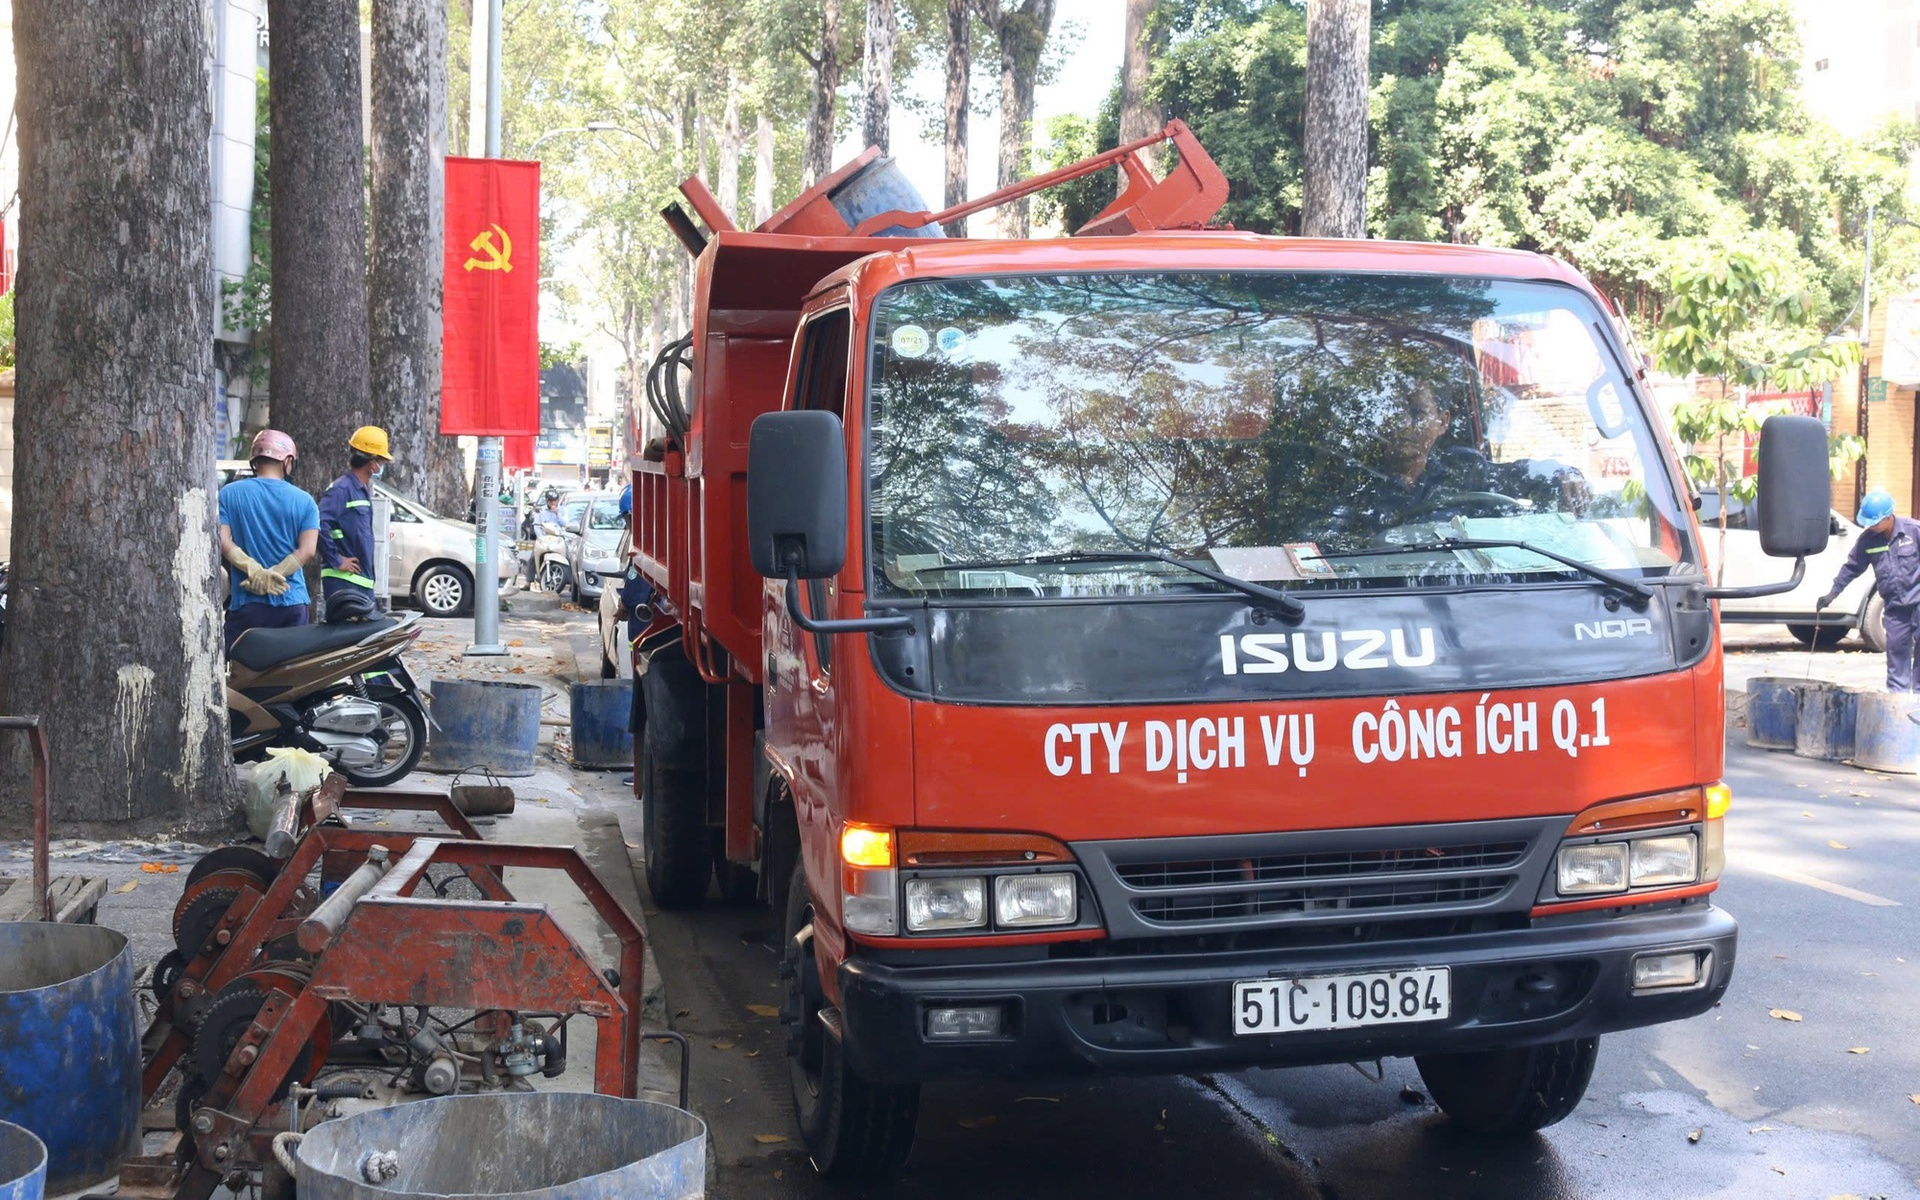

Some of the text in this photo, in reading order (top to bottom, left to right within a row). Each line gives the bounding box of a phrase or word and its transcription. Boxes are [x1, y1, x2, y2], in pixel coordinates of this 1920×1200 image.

[1219, 627, 1436, 675] ISUZU
[1574, 617, 1653, 641] NQR
[1043, 693, 1610, 784] CTY DỊCH VỤ CÔNG ÍCH Q.1
[1242, 974, 1442, 1028] 51C-109.84
